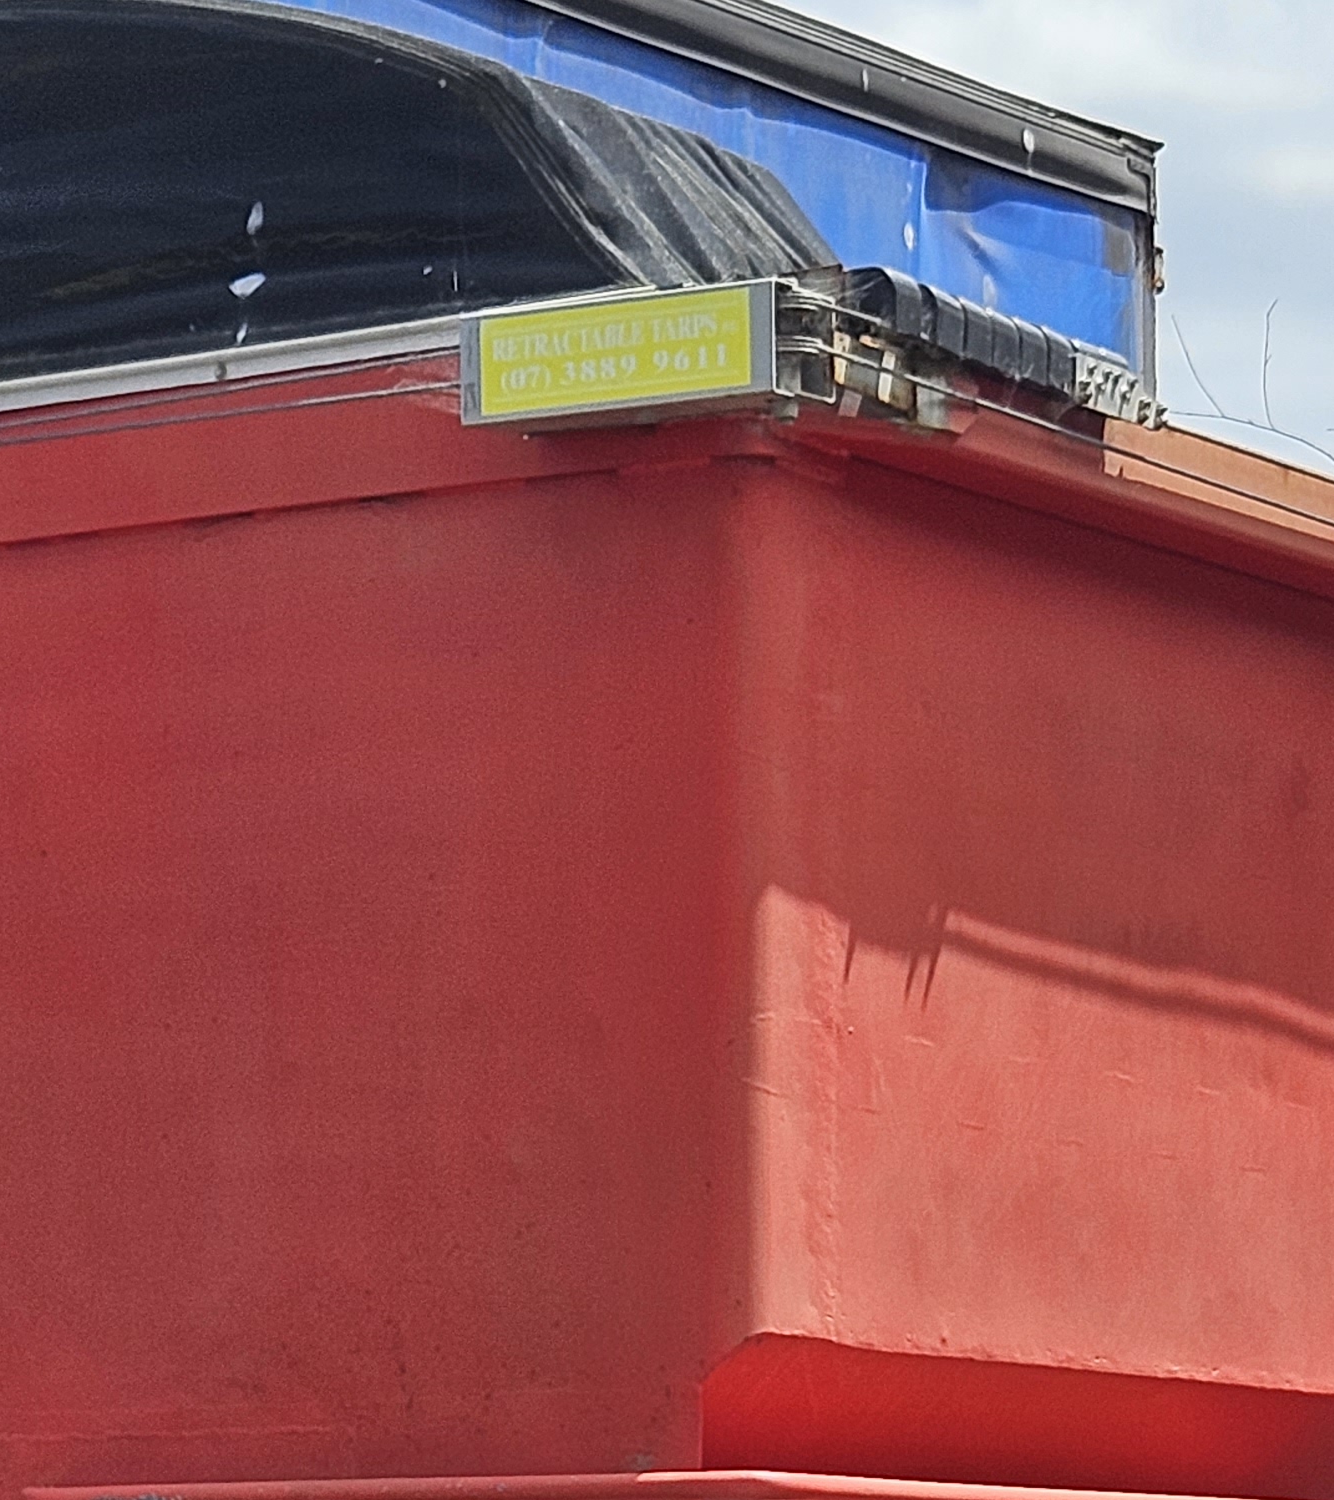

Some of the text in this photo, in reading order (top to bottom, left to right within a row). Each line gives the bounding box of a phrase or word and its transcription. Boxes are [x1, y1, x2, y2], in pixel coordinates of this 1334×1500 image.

[491, 319, 646, 362] RETRACTABLE
[651, 311, 719, 344] TARPS
[500, 342, 727, 395] (07) 3889 9611
